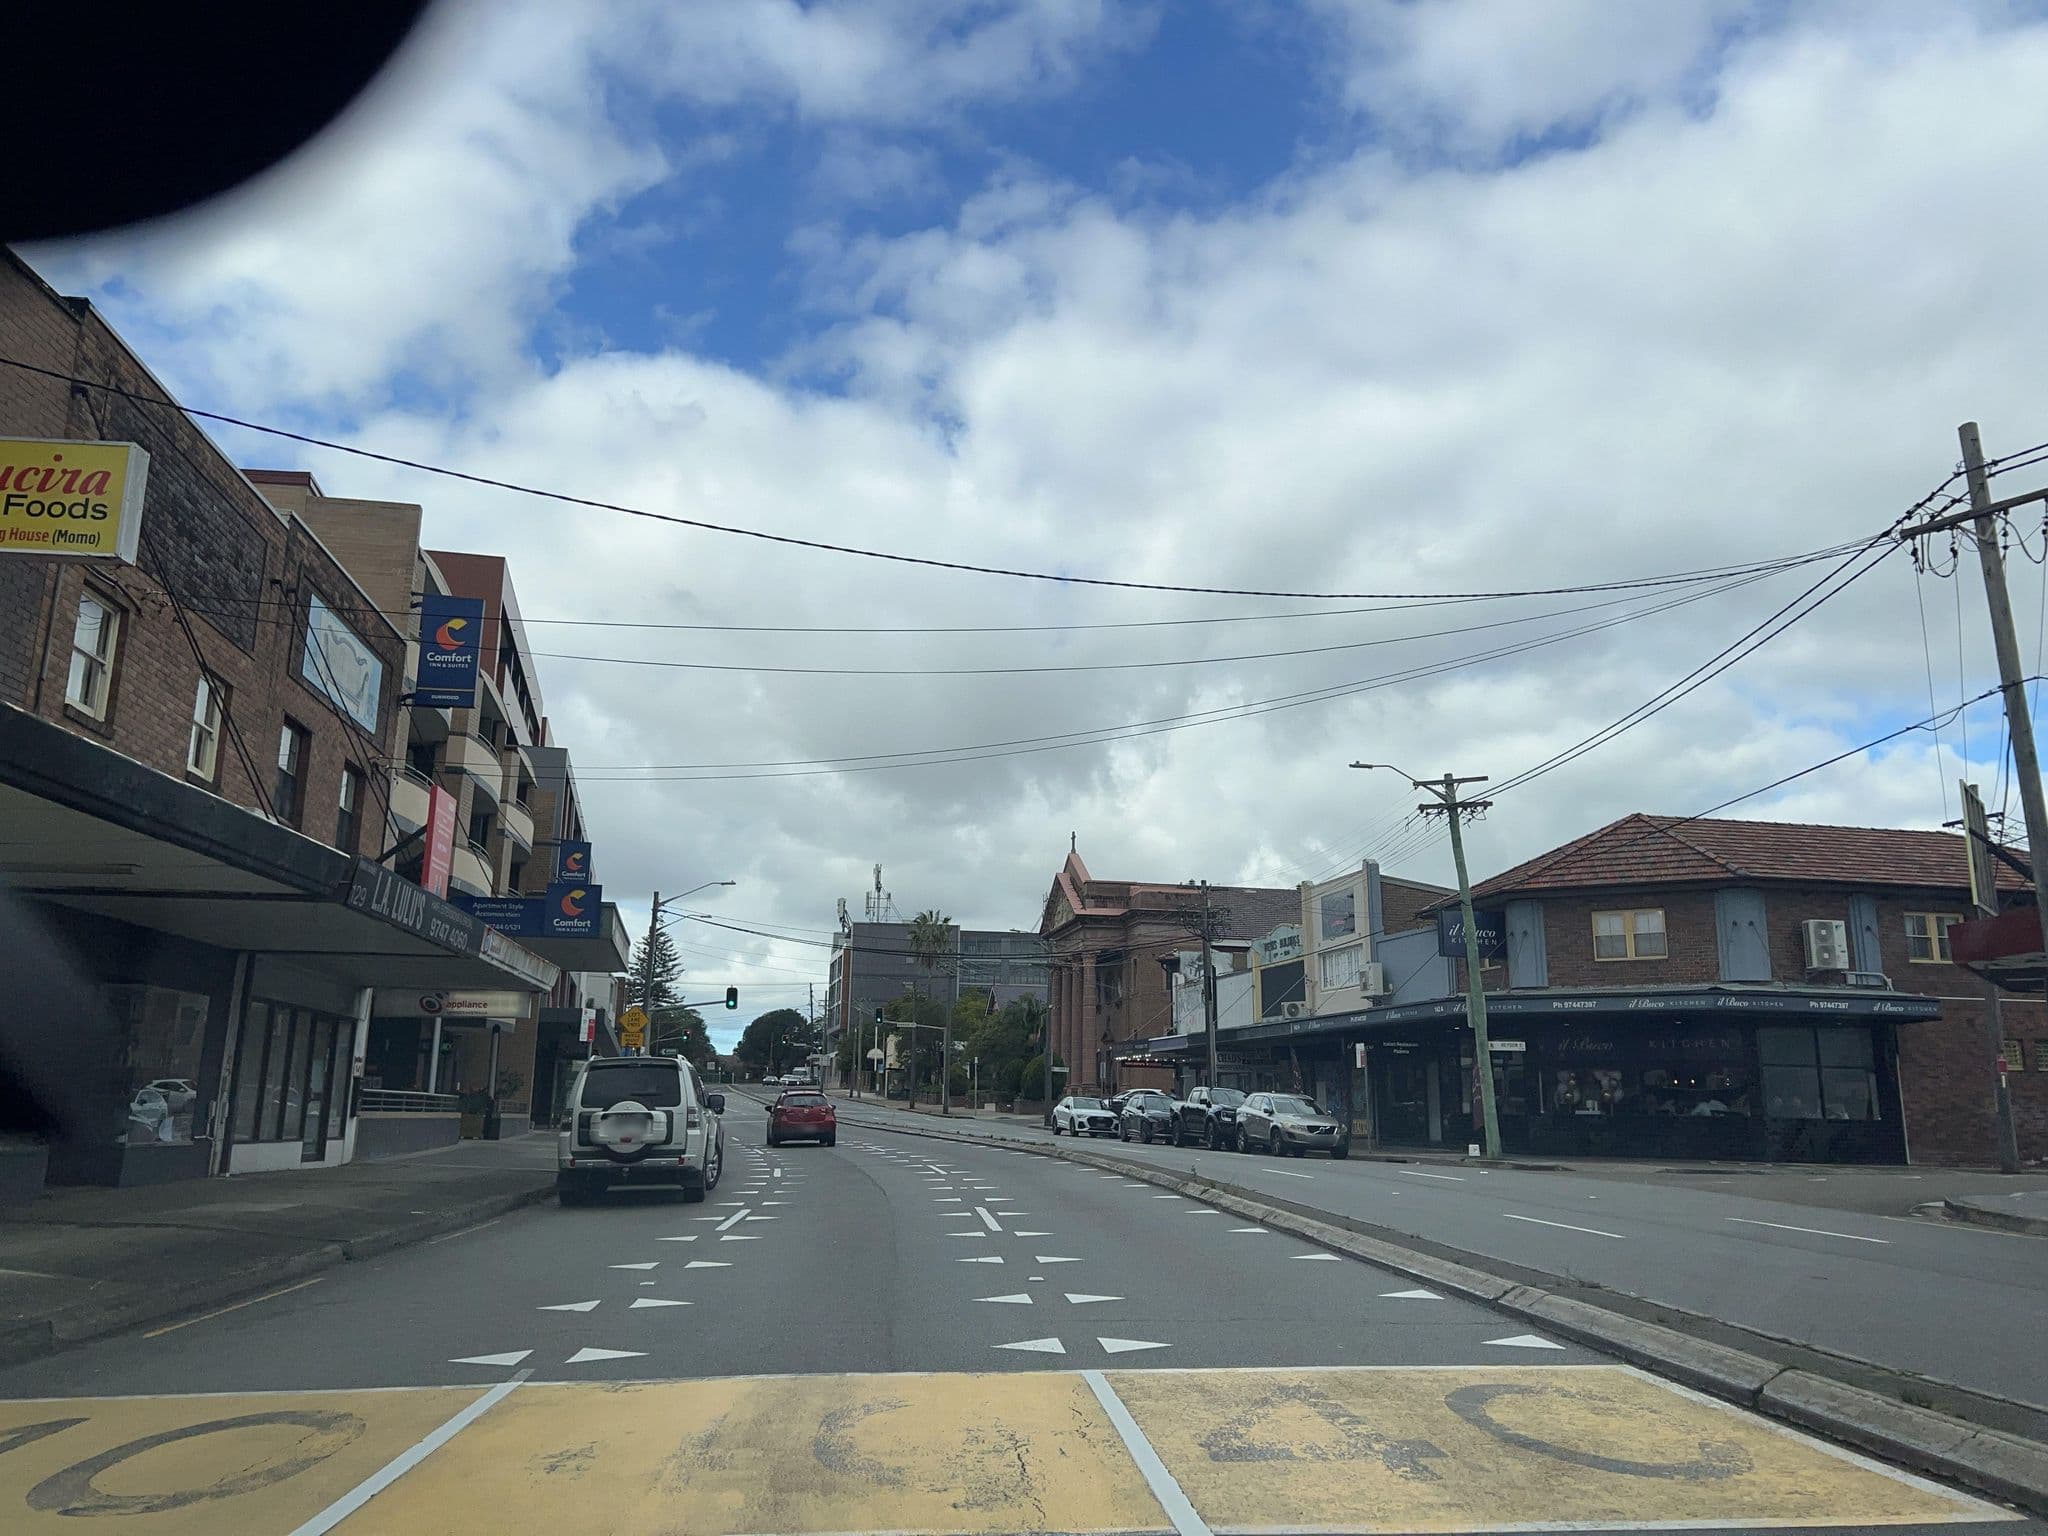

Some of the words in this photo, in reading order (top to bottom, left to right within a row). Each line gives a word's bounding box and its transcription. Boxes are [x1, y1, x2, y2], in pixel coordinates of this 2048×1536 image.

[3, 494, 108, 520] Foods
[9, 527, 49, 542] House
[52, 529, 100, 547] (Momo)
[427, 652, 472, 663] Comfort
[391, 881, 426, 930] LULU'S
[473, 902, 507, 910] Apartment
[553, 918, 591, 927] Comfort
[430, 918, 450, 942] 9747
[1448, 923, 1460, 936] il
[1461, 926, 1496, 937] uco
[1452, 937, 1497, 945] KITHEN
[446, 1000, 488, 1009] appliance
[1628, 999, 1637, 1008] il
[1638, 999, 1665, 1008] Buco
[1717, 996, 1725, 1006] il
[1725, 996, 1749, 1006] Buco
